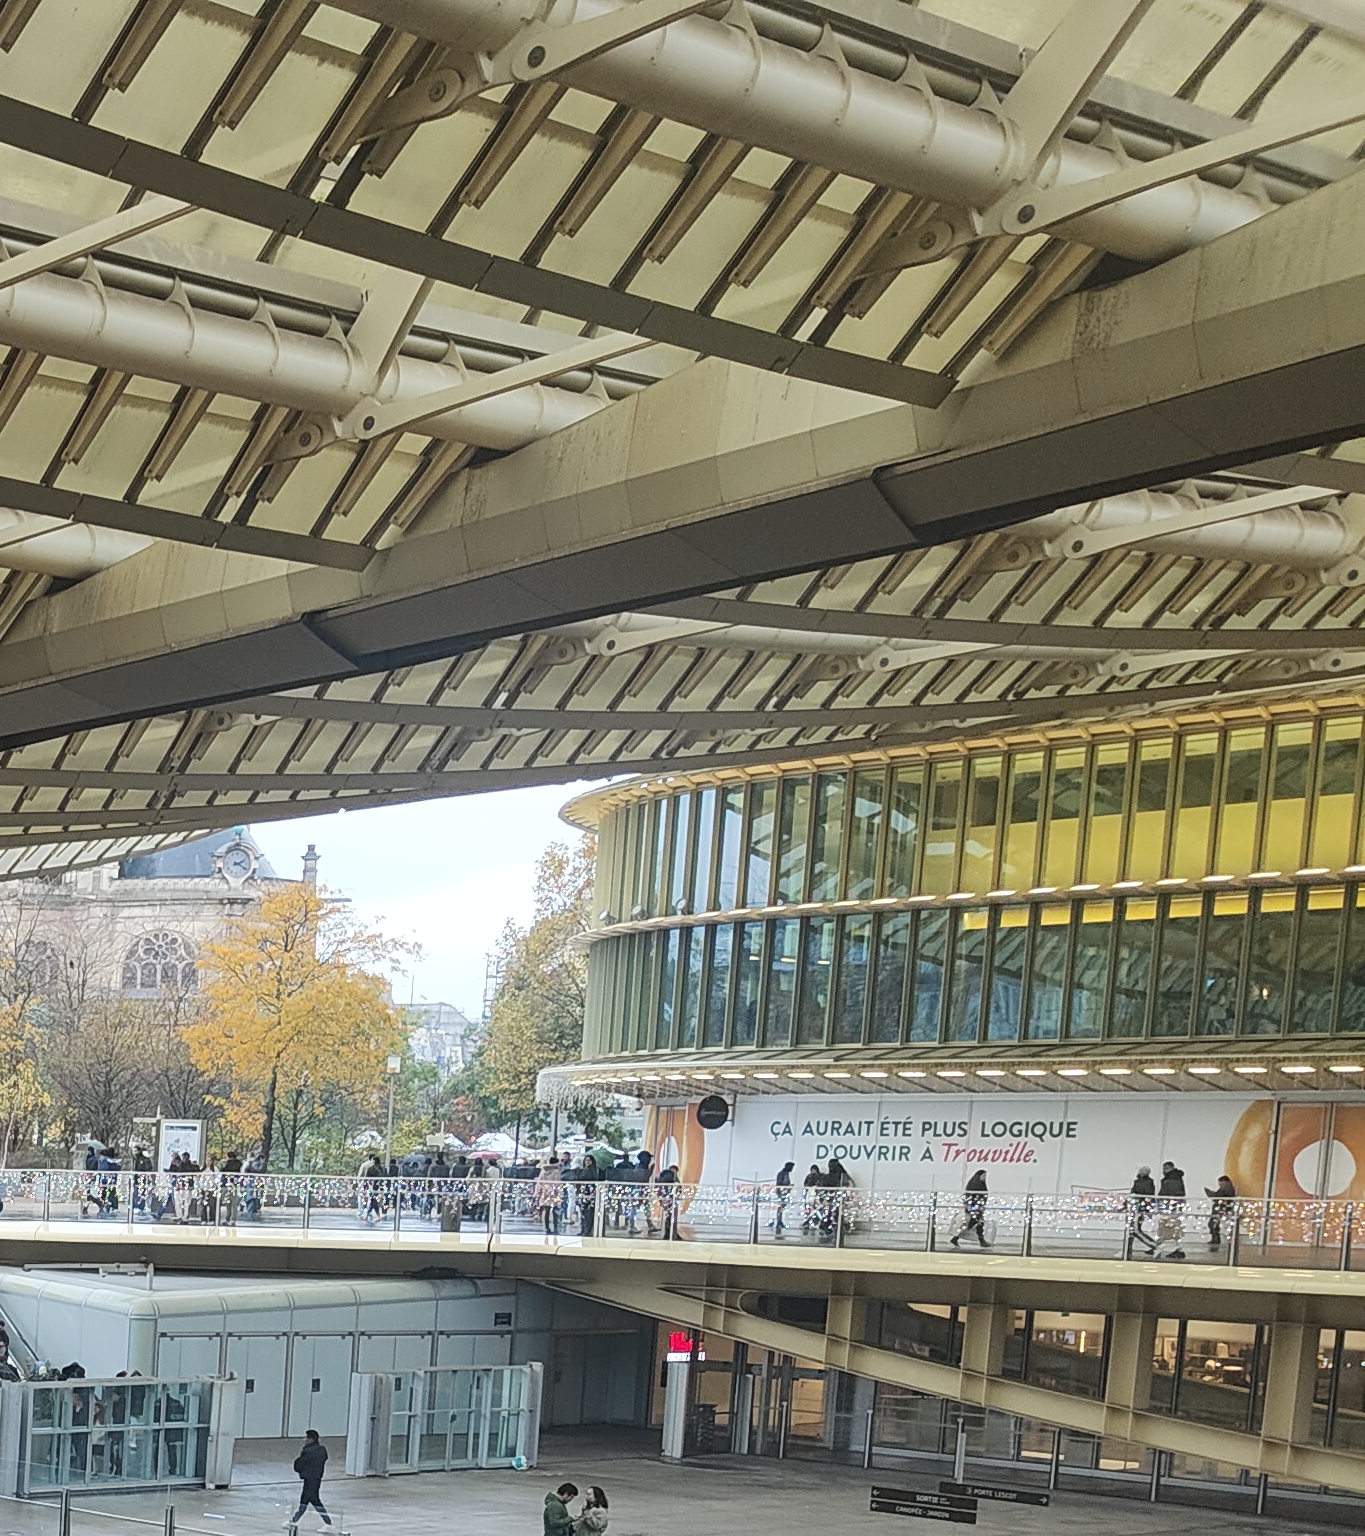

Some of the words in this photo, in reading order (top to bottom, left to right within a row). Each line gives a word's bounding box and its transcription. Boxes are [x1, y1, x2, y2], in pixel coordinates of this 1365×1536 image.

[770, 1119, 793, 1142] ÇA
[802, 1119, 874, 1138] AURAIT
[879, 1115, 913, 1138] ÉTÉ
[921, 1120, 968, 1138] PLUS
[980, 1120, 1079, 1143] LOGIQUE
[816, 1143, 911, 1162] D'OUVRIR
[920, 1140, 935, 1162] À
[941, 1141, 1038, 1164] Trouville.
